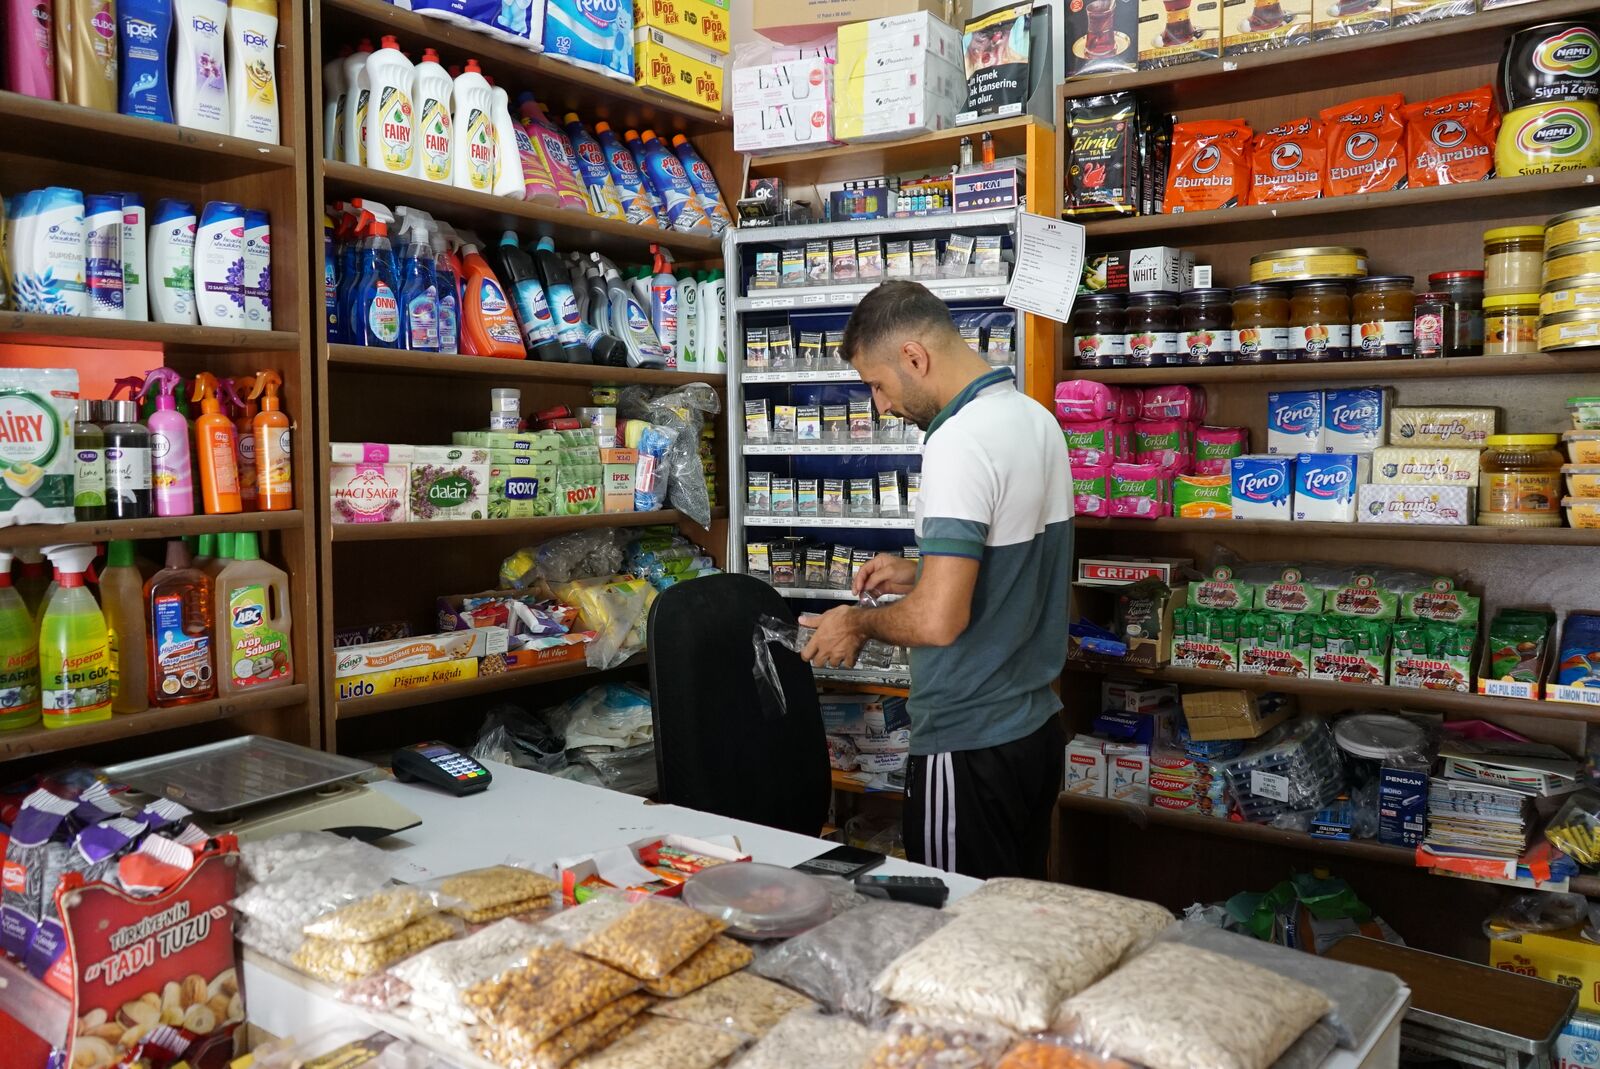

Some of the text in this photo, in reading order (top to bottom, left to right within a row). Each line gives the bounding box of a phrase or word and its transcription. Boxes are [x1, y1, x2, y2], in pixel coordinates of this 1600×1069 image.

[1556, 46, 1591, 57] NAMLI
[976, 69, 998, 84] içmek
[978, 78, 1018, 93] kanserine
[1535, 83, 1599, 99] Siyah Zeytin
[384, 123, 411, 142] FAIRY
[1536, 127, 1574, 139] NAMLI
[426, 134, 449, 153] FAIRY
[1330, 156, 1398, 180] Eburabia
[1174, 174, 1232, 188] Eburabia
[1254, 170, 1318, 187] Eburabia
[1133, 267, 1157, 282] WHITE
[375, 297, 396, 309] ONNO
[1275, 405, 1313, 426] Teno
[1332, 404, 1372, 425] Teno
[1069, 434, 1094, 446] Orkid
[1144, 436, 1169, 447] Orkid
[1205, 446, 1231, 456] Orkid
[1239, 472, 1279, 494] Teno
[1305, 469, 1347, 490] Teno
[335, 488, 364, 499] HACI
[430, 485, 467, 499] dalan
[508, 482, 537, 496] ROXY
[1120, 482, 1146, 493] Orkid
[1194, 487, 1219, 498] Orkid
[566, 486, 597, 504] ROXY
[1204, 581, 1234, 590] FUNDA
[1273, 584, 1304, 593] FUNDA
[1345, 588, 1377, 596] FUNDA
[1423, 592, 1457, 601] FUNDA
[238, 610, 260, 623] ABC
[236, 637, 261, 650] Arap
[245, 640, 281, 657] Sabunu
[1184, 642, 1220, 652] FUNDA
[62, 649, 104, 669] Asperox
[1254, 649, 1291, 659] FUNDA
[1326, 654, 1365, 665] FUNDA
[1407, 660, 1451, 671] FUNDA
[393, 668, 462, 688] Pişirme Kağıdı
[340, 680, 375, 699] Lido
[1150, 778, 1184, 789] Colgate
[1385, 776, 1422, 786] PENSAN
[1155, 796, 1189, 807] Colgate
